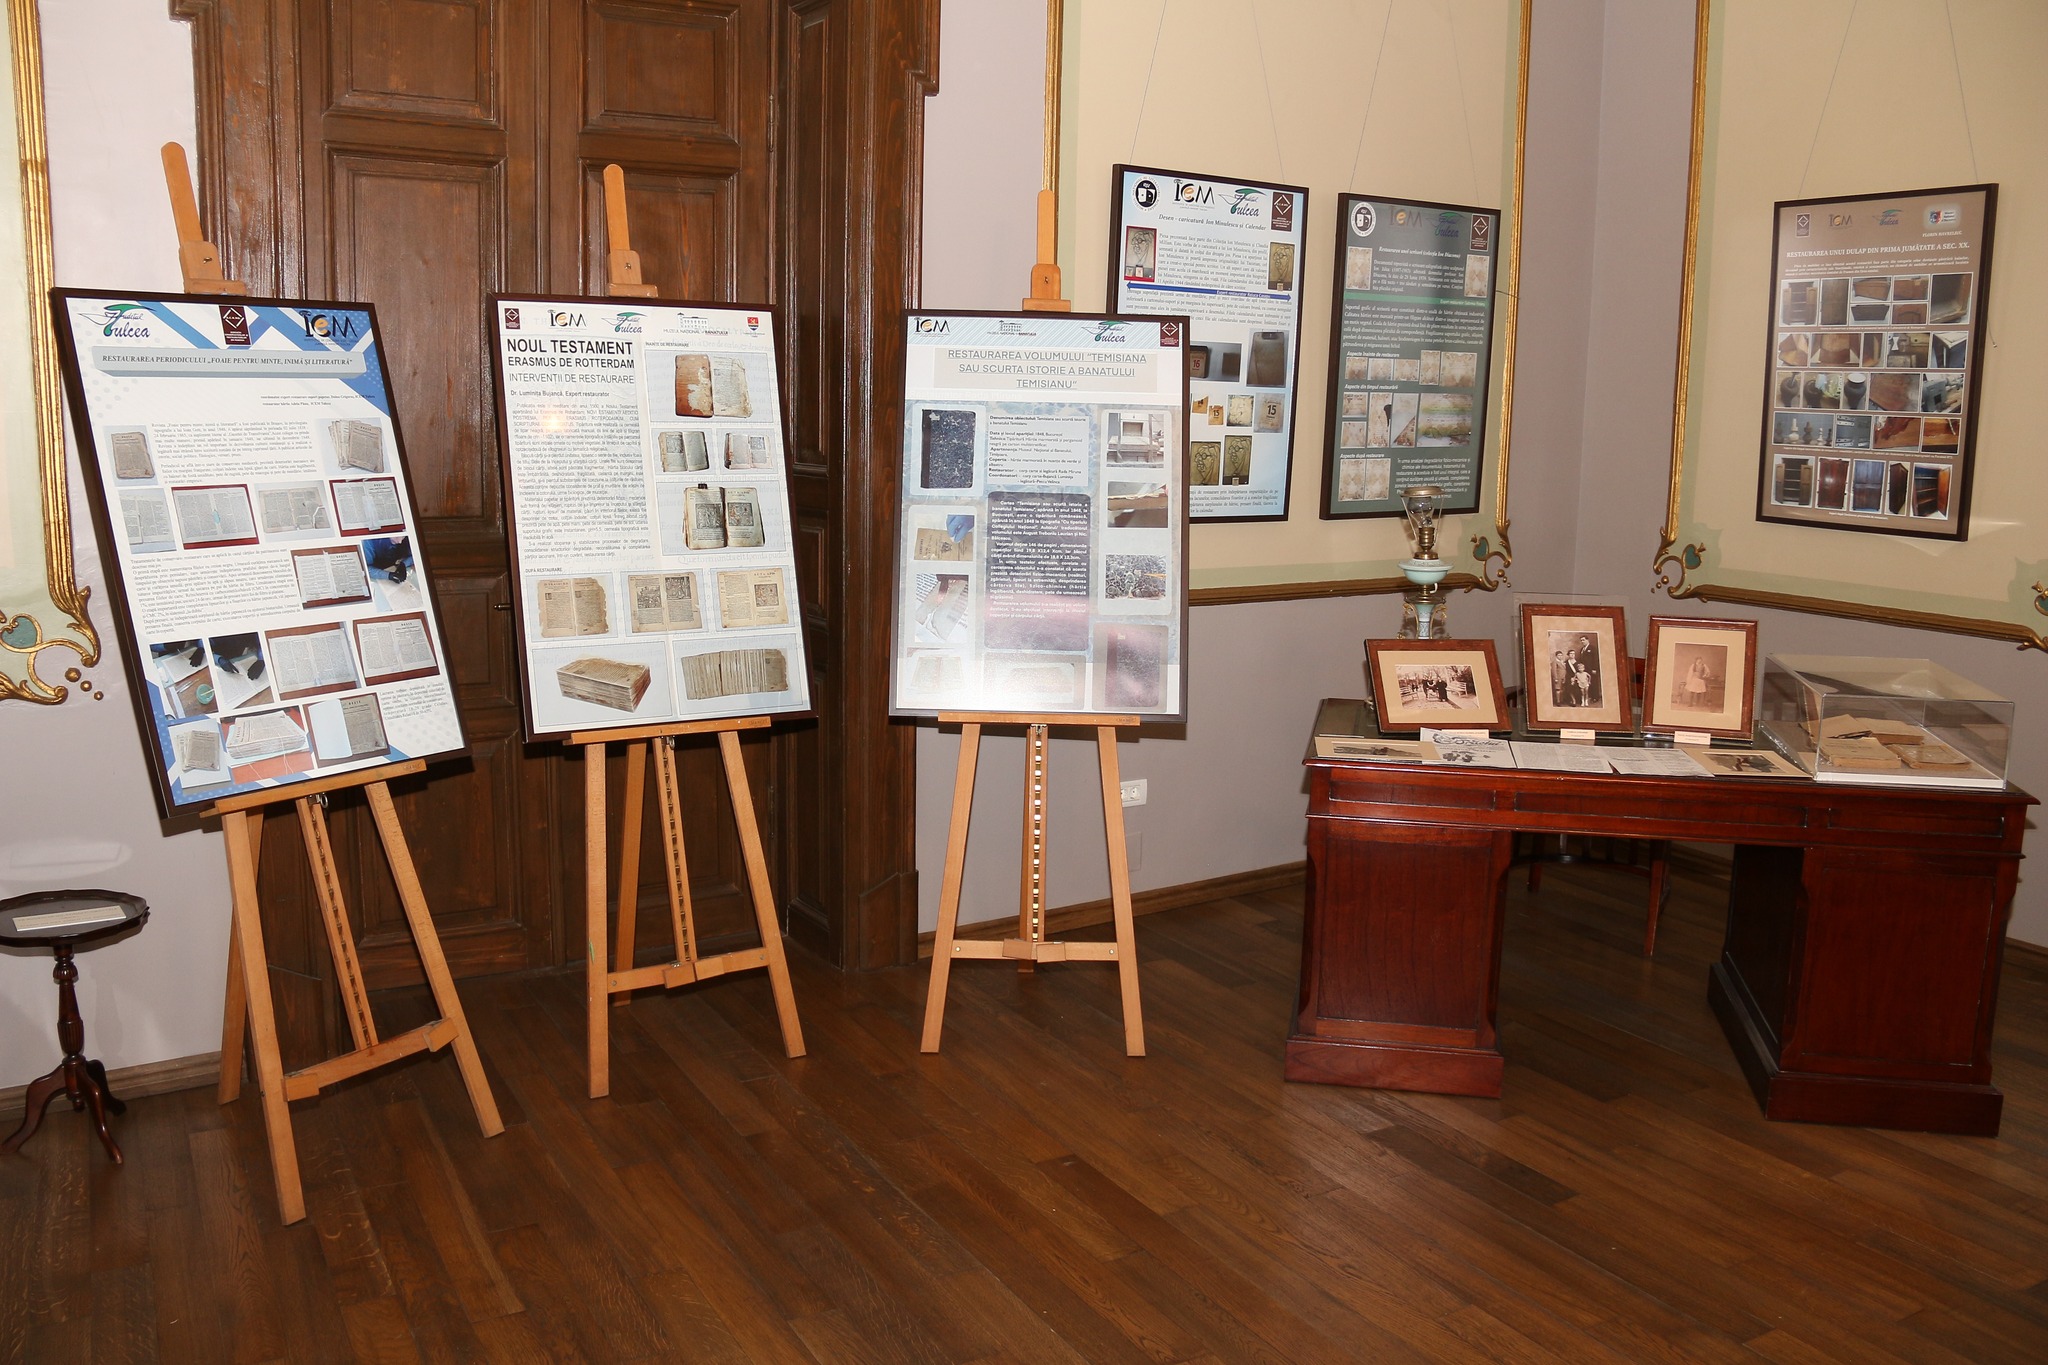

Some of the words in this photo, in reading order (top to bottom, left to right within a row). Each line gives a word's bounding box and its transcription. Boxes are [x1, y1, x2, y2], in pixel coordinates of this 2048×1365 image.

[507, 339, 547, 352] NOUL
[550, 340, 632, 354] TESTAMENT
[948, 350, 1021, 359] RESTAURAREA
[1024, 352, 1084, 361] VOLUMULUI
[508, 357, 556, 366] ERASMUS
[560, 358, 572, 367] DE
[576, 358, 634, 368] ROTTERDAM
[959, 364, 979, 372] SAU
[983, 364, 1023, 373] SCURTA
[1026, 365, 1065, 374] ISTORIE
[1079, 367, 1134, 376] BANATULUI
[565, 374, 576, 382] DE
[580, 375, 634, 384] RESTAURARE
[1267, 405, 1276, 415] 15
